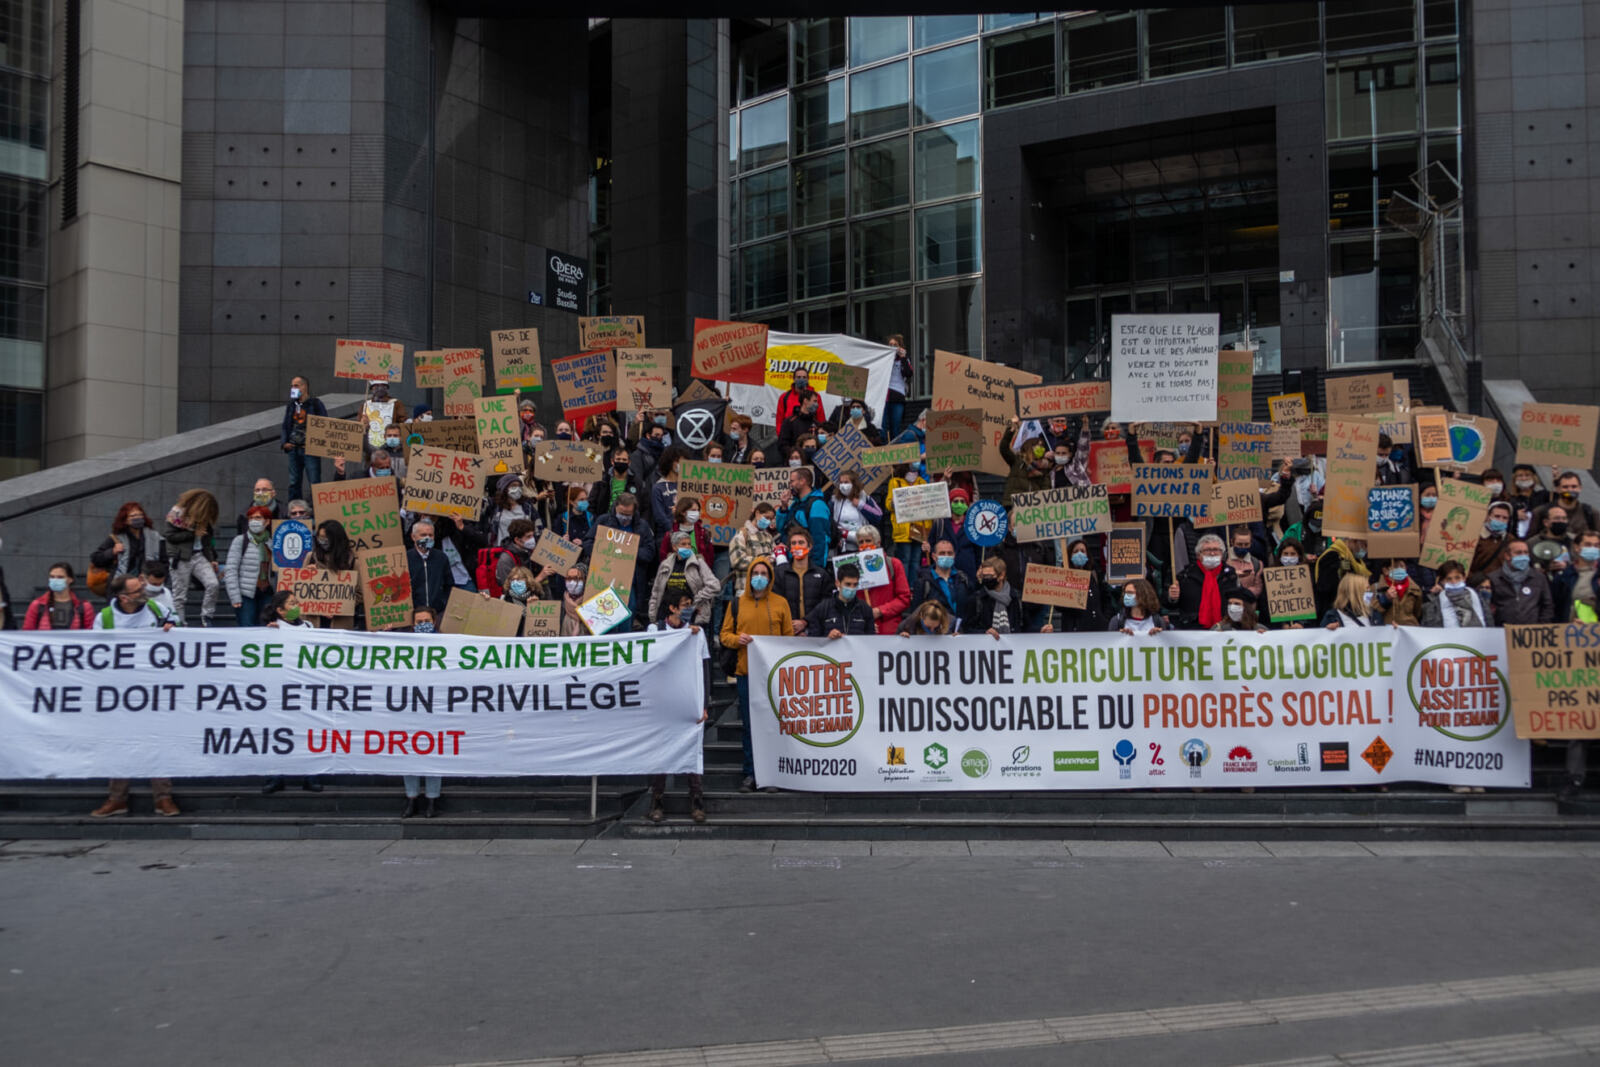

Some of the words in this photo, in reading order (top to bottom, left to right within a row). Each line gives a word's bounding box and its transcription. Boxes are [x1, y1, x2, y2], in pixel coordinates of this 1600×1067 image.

[557, 288, 577, 300] Studio
[556, 298, 578, 310] Bastille
[498, 332, 515, 341] PAS
[520, 331, 530, 340] DE
[1150, 325, 1168, 335] QUE
[1172, 325, 1182, 335] LE
[697, 338, 709, 351] NO
[1121, 338, 1138, 346] EST
[1155, 338, 1198, 346] IMPORTANT
[444, 349, 481, 365] SEMONS
[501, 347, 530, 355] CULTURE
[701, 356, 718, 371] NO
[719, 341, 761, 364] FUTURE
[453, 364, 475, 376] UNE
[498, 364, 536, 375] NATURE
[558, 372, 576, 383] POUR
[582, 363, 607, 376] NOTRE
[1170, 380, 1192, 388] MORDS
[481, 400, 507, 413] UNE
[563, 393, 586, 408] CRIME
[1038, 401, 1061, 412] NON
[1272, 400, 1302, 409] TRIONS
[310, 418, 324, 428] DES
[329, 422, 364, 434] PRODUITS
[477, 416, 513, 435] PAC
[1535, 411, 1548, 422] DE
[1550, 412, 1582, 427] VIANDE
[482, 437, 518, 449] RESPON
[942, 431, 959, 441] BIO
[1534, 438, 1544, 449] DE
[310, 437, 327, 447] POUR
[340, 442, 360, 452] CORPS
[827, 435, 854, 469] TOUT
[1232, 441, 1272, 453] BOUFFE
[489, 450, 513, 459] SABLE
[926, 453, 980, 471] ENFANTS
[424, 453, 447, 469] JE
[453, 456, 472, 472] NE
[510, 464, 522, 472] YES
[449, 472, 475, 489] PAS
[681, 463, 754, 483] L'AMAZONIE
[1135, 467, 1184, 479] SEMONS
[1190, 468, 1208, 478] UN
[1217, 467, 1231, 480] LA
[405, 485, 434, 500] ROUND
[436, 491, 449, 502] UP
[449, 492, 480, 507] READY
[681, 482, 709, 494] BRULE
[712, 484, 732, 495] DANS
[734, 486, 753, 497] NOS
[1011, 491, 1040, 507] NOUS
[1042, 486, 1089, 504] VOULONS
[1091, 484, 1107, 497] DES
[1136, 482, 1200, 495] AVENIR
[342, 501, 371, 517] LES
[1227, 494, 1255, 510] BIEN
[1015, 499, 1108, 525] AGRICULTEURS
[1137, 503, 1208, 517] DURABLE
[1036, 518, 1098, 538] HEUREUX
[349, 534, 383, 551] PAS
[1446, 539, 1477, 552] DONC
[366, 554, 388, 567] UNE
[282, 568, 318, 582] STOP
[337, 570, 352, 582] LA
[368, 566, 390, 578] PAC
[1266, 567, 1306, 582] DETER
[530, 602, 556, 615] VIVE
[371, 614, 405, 627] SABLE
[534, 619, 547, 627] LES
[1511, 626, 1560, 649] NOTRE
[1565, 624, 1600, 648] ASS
[12, 642, 137, 671] PARCE
[149, 642, 227, 670] QUE
[240, 644, 284, 668] SE
[297, 645, 447, 670] NOURRIR
[458, 638, 656, 670] SAINEMENT
[878, 650, 950, 686] POUR
[959, 649, 1014, 685] UNE
[1022, 646, 1213, 683] AGRICULTURE
[1222, 638, 1393, 682] ÉCOLOGIQUE
[1532, 650, 1574, 669] DOIT
[779, 661, 853, 696] NOTRE
[1420, 655, 1499, 688] NOTRE
[32, 686, 83, 713] NE
[96, 684, 184, 713] DOIT
[196, 684, 267, 711] PAS
[281, 684, 372, 712] ETRE
[386, 685, 434, 713] UN
[447, 675, 642, 713] PRIVILÈGE
[1419, 686, 1500, 711] ASSIETTE
[1548, 690, 1578, 708] PAS
[779, 693, 853, 719] ASSIETTE
[878, 694, 1089, 733] INDISSOCIABLE
[1098, 694, 1134, 730] DU
[1143, 685, 1274, 729] PROGRÈS
[1281, 689, 1381, 727] SOCIAL
[779, 720, 807, 735] POUR
[809, 716, 853, 734] DEMAIN
[1419, 712, 1451, 728] POUR
[1453, 709, 1499, 727] DEMAIN
[1529, 711, 1598, 733] DETRU
[202, 727, 295, 755] MAIS
[307, 729, 351, 754] UN
[364, 730, 466, 755] DROIT
[778, 757, 857, 776] #NAPD2020
[961, 758, 988, 769] amap
[1414, 748, 1504, 770] #NAPD2020
[1001, 765, 1042, 773] générations
[1148, 768, 1166, 776] attac
